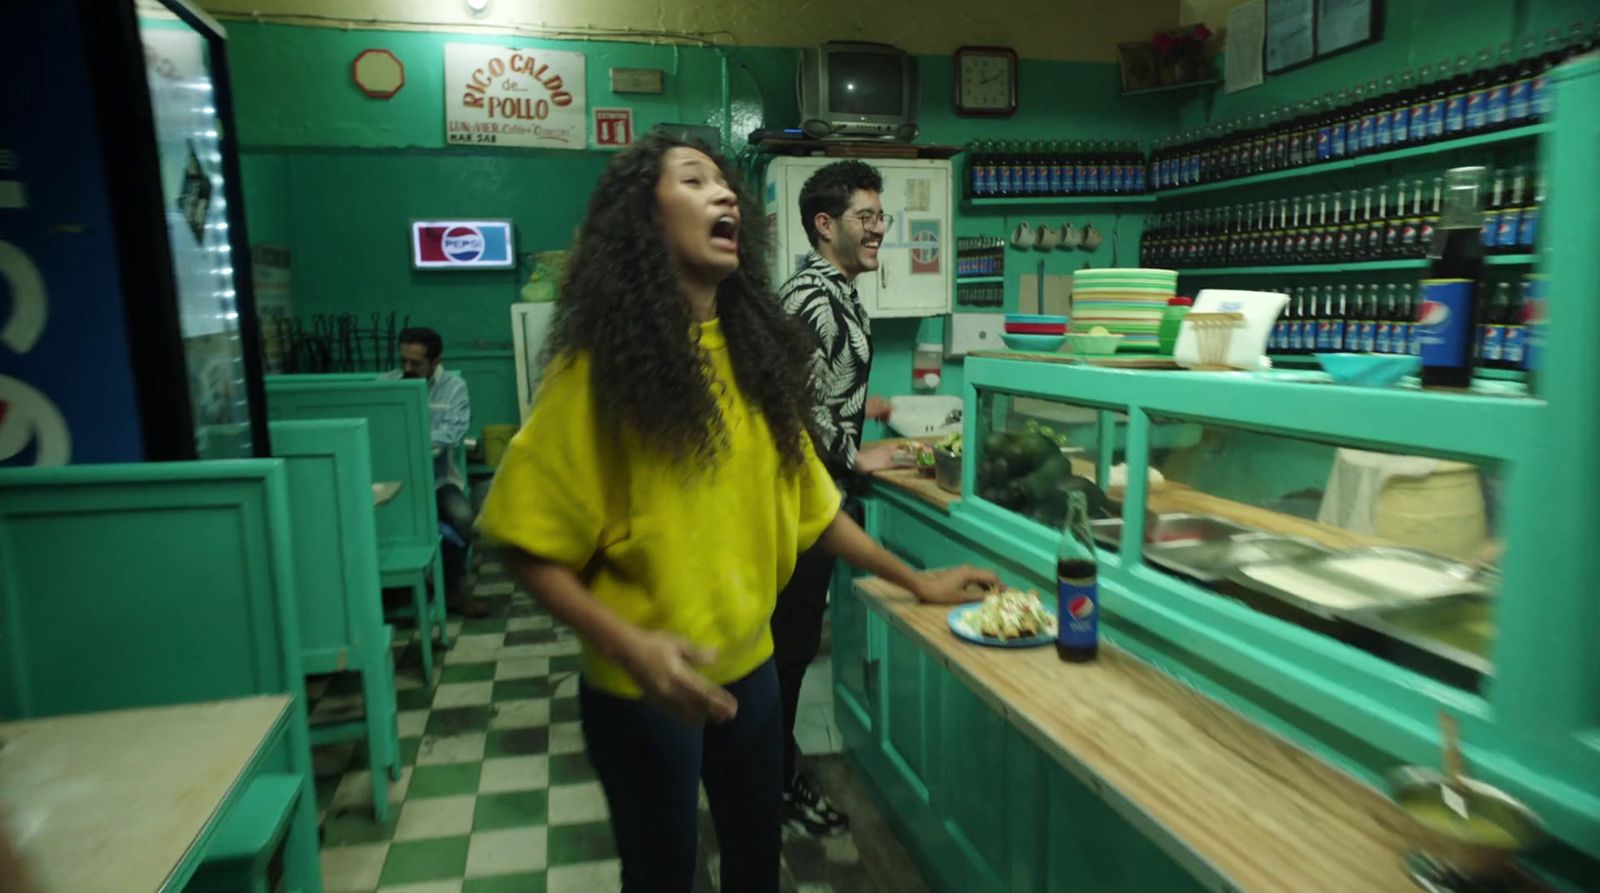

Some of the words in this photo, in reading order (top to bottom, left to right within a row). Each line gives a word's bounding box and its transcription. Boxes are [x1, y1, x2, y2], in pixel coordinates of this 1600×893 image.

[463, 57, 505, 108] RICO
[510, 54, 573, 107] CALDO
[502, 78, 519, 92] de
[488, 97, 549, 120] POLLO
[445, 240, 482, 248] PEPSI
